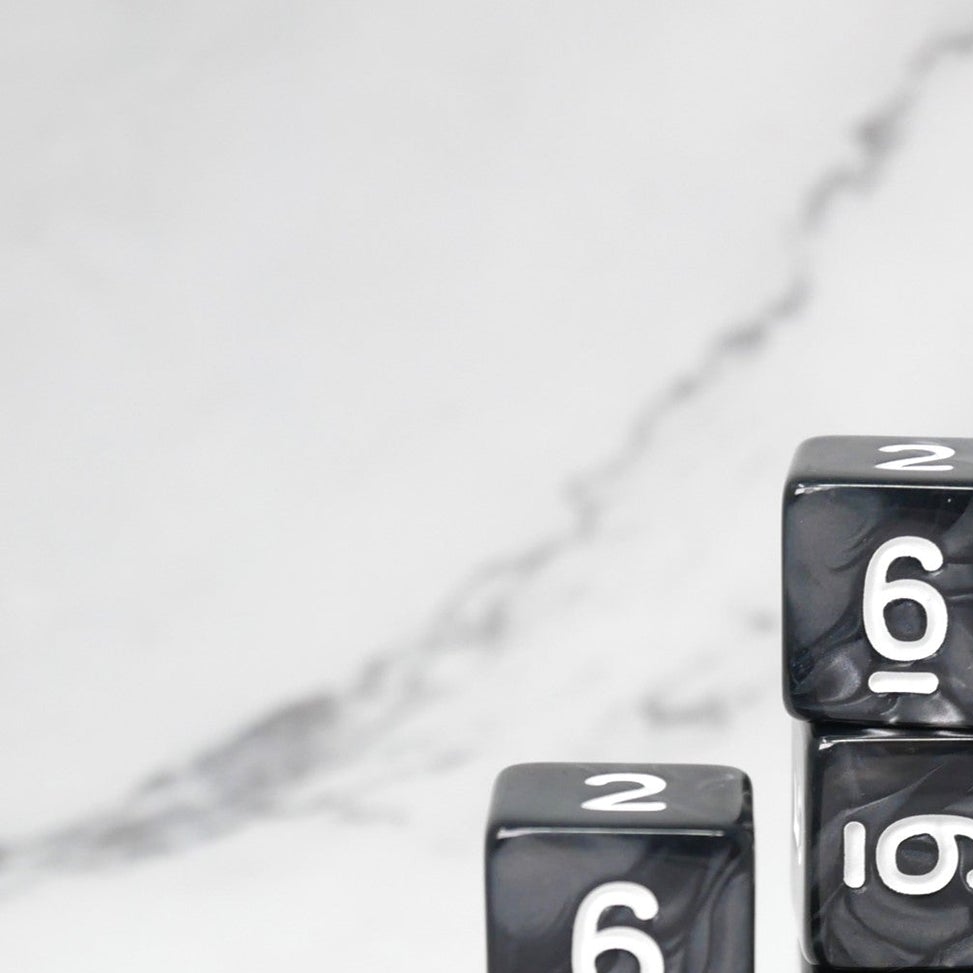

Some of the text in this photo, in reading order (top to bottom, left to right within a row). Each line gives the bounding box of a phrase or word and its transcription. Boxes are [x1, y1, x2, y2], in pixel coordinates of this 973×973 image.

[874, 443, 956, 472] 2
[861, 535, 949, 696] 6
[579, 772, 670, 813] 2
